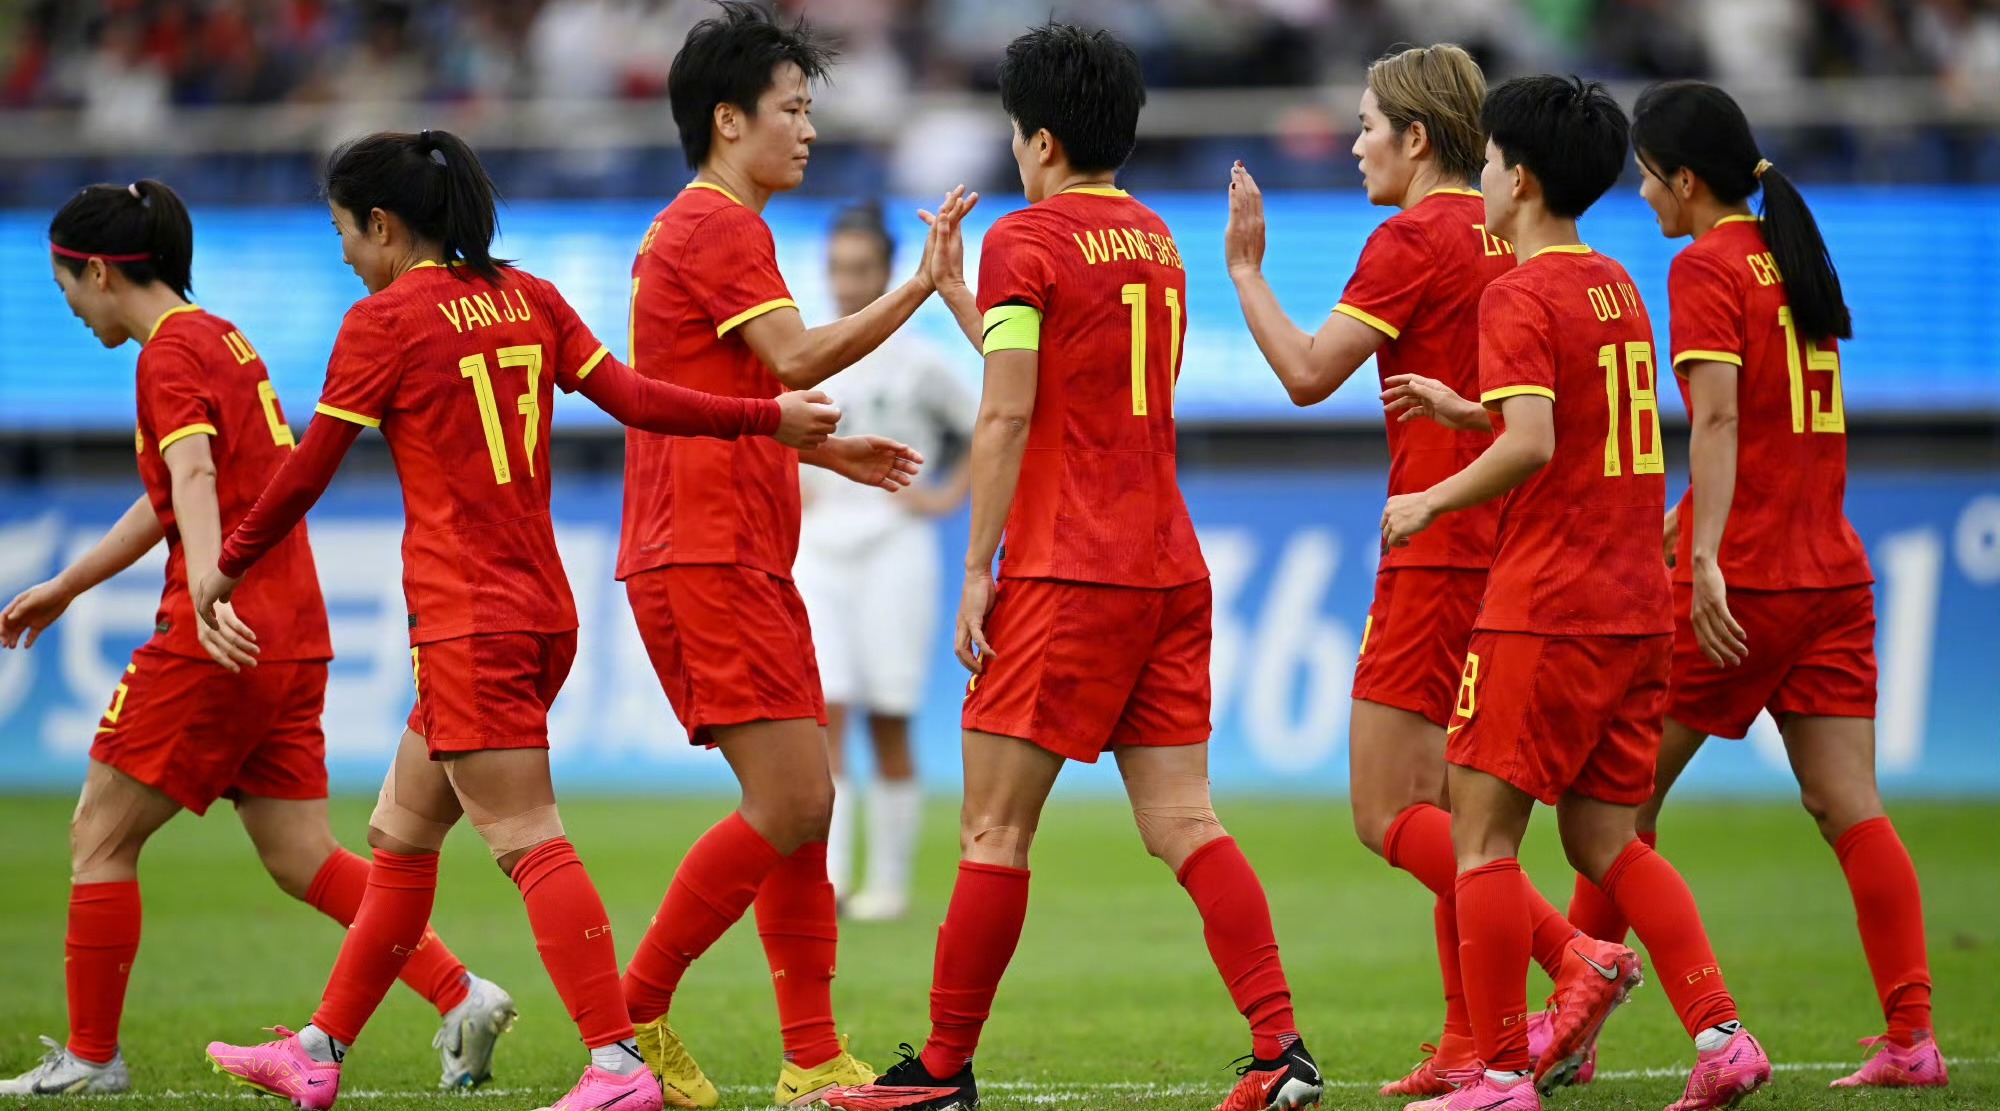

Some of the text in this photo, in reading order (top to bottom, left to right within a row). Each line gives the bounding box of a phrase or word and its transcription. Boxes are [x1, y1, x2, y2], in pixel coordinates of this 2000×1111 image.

[1072, 228, 1185, 270] WANG SHS
[1472, 224, 1515, 256] ZH
[1747, 252, 1784, 286] CH
[437, 289, 531, 334] YAN JJ
[1587, 283, 1621, 322] OU
[1121, 283, 1180, 419] 11
[1778, 306, 1845, 433] 15
[458, 344, 542, 485] 17
[1598, 341, 1665, 477] 18
[1194, 525, 1378, 773] 36
[391, 944, 416, 957] CF
[584, 924, 612, 940] CF
[1503, 1012, 1527, 1027] CF
